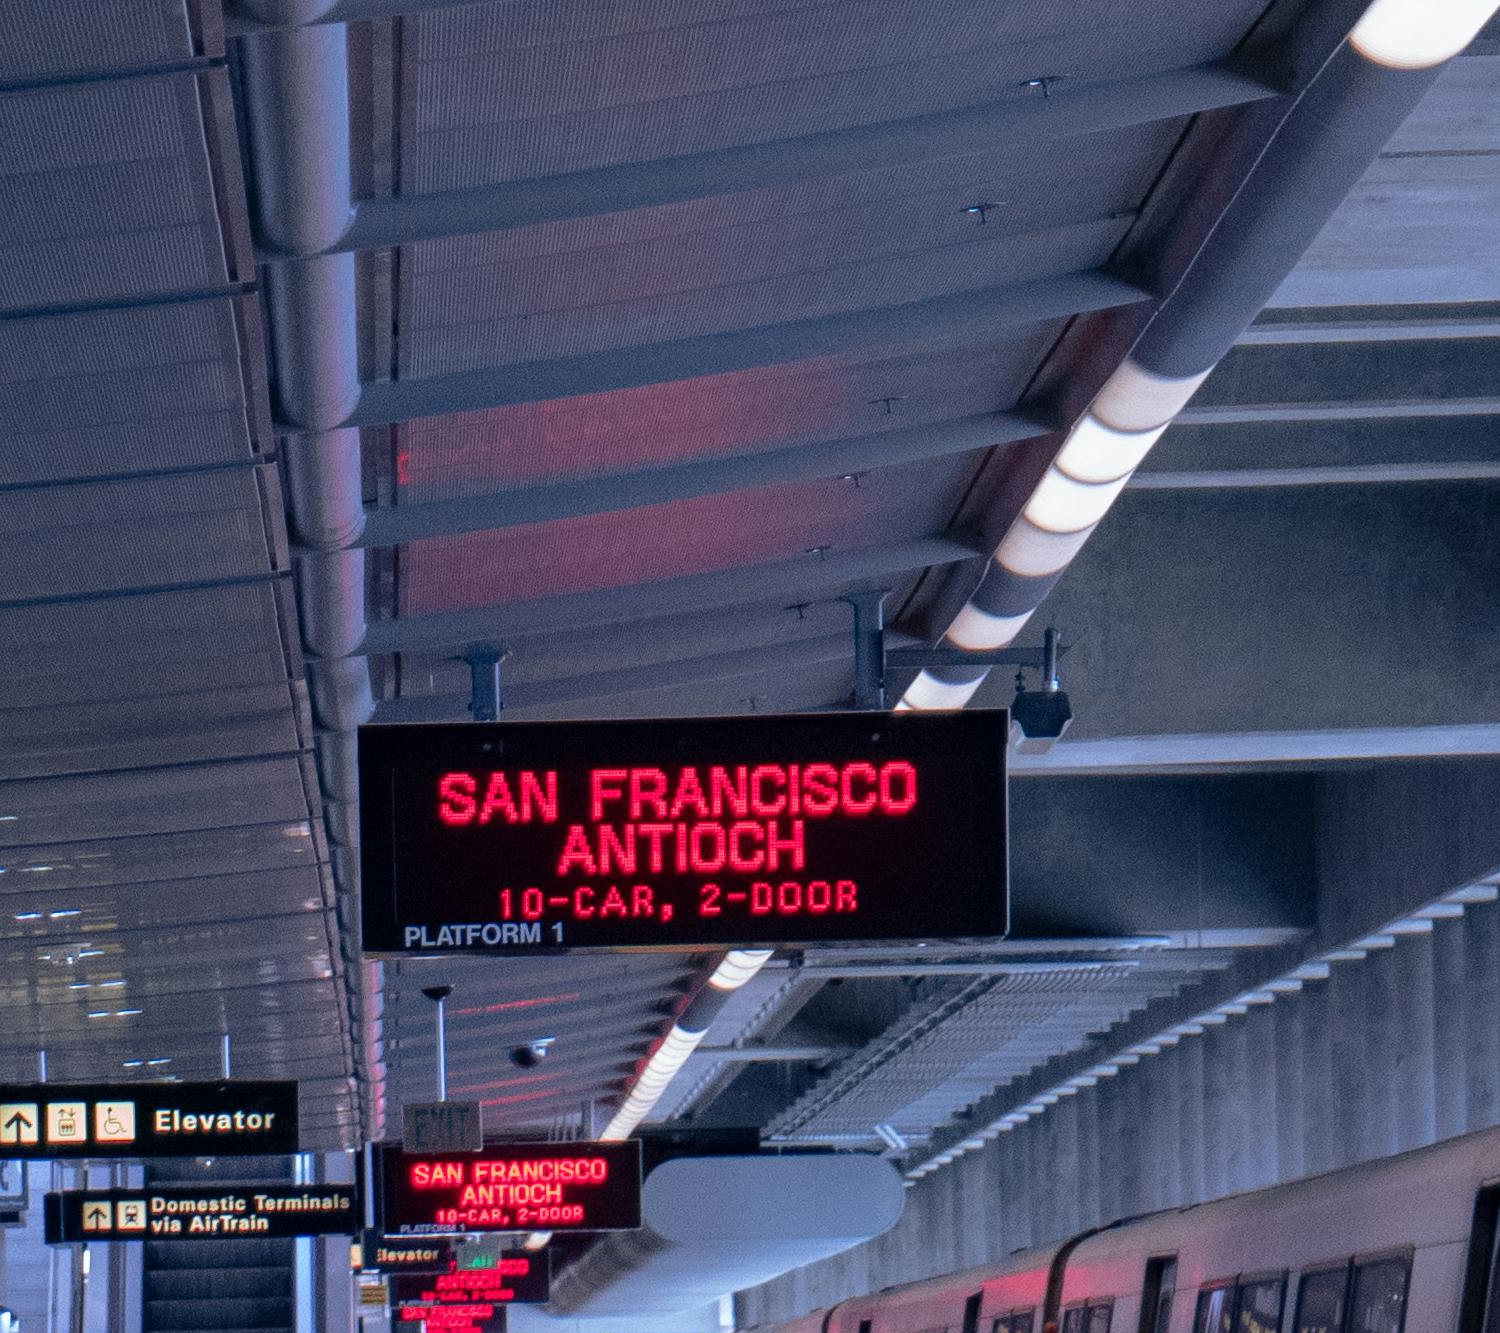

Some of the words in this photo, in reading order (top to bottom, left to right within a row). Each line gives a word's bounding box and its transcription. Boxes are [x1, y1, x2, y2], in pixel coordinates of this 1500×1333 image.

[438, 771, 558, 826] SAN
[590, 761, 918, 820] FRANCISCO
[558, 820, 806, 876] ANTIOCH
[500, 884, 674, 923] 10-CAR,
[699, 880, 859, 918] 2-DOOR
[404, 923, 543, 948] PLATFORM
[551, 923, 565, 943] 1
[154, 1108, 276, 1132] Elevator
[411, 1162, 463, 1185] SAN
[474, 1158, 608, 1182] FRANCISCO
[151, 1195, 246, 1214] Domestic
[253, 1194, 350, 1213] Terminals
[461, 1183, 564, 1206] ANTIOCH
[151, 1216, 181, 1233] via
[189, 1214, 270, 1233] AirTrain
[436, 1208, 510, 1225] 10-CAR,
[519, 1206, 585, 1222] 2-DOOR
